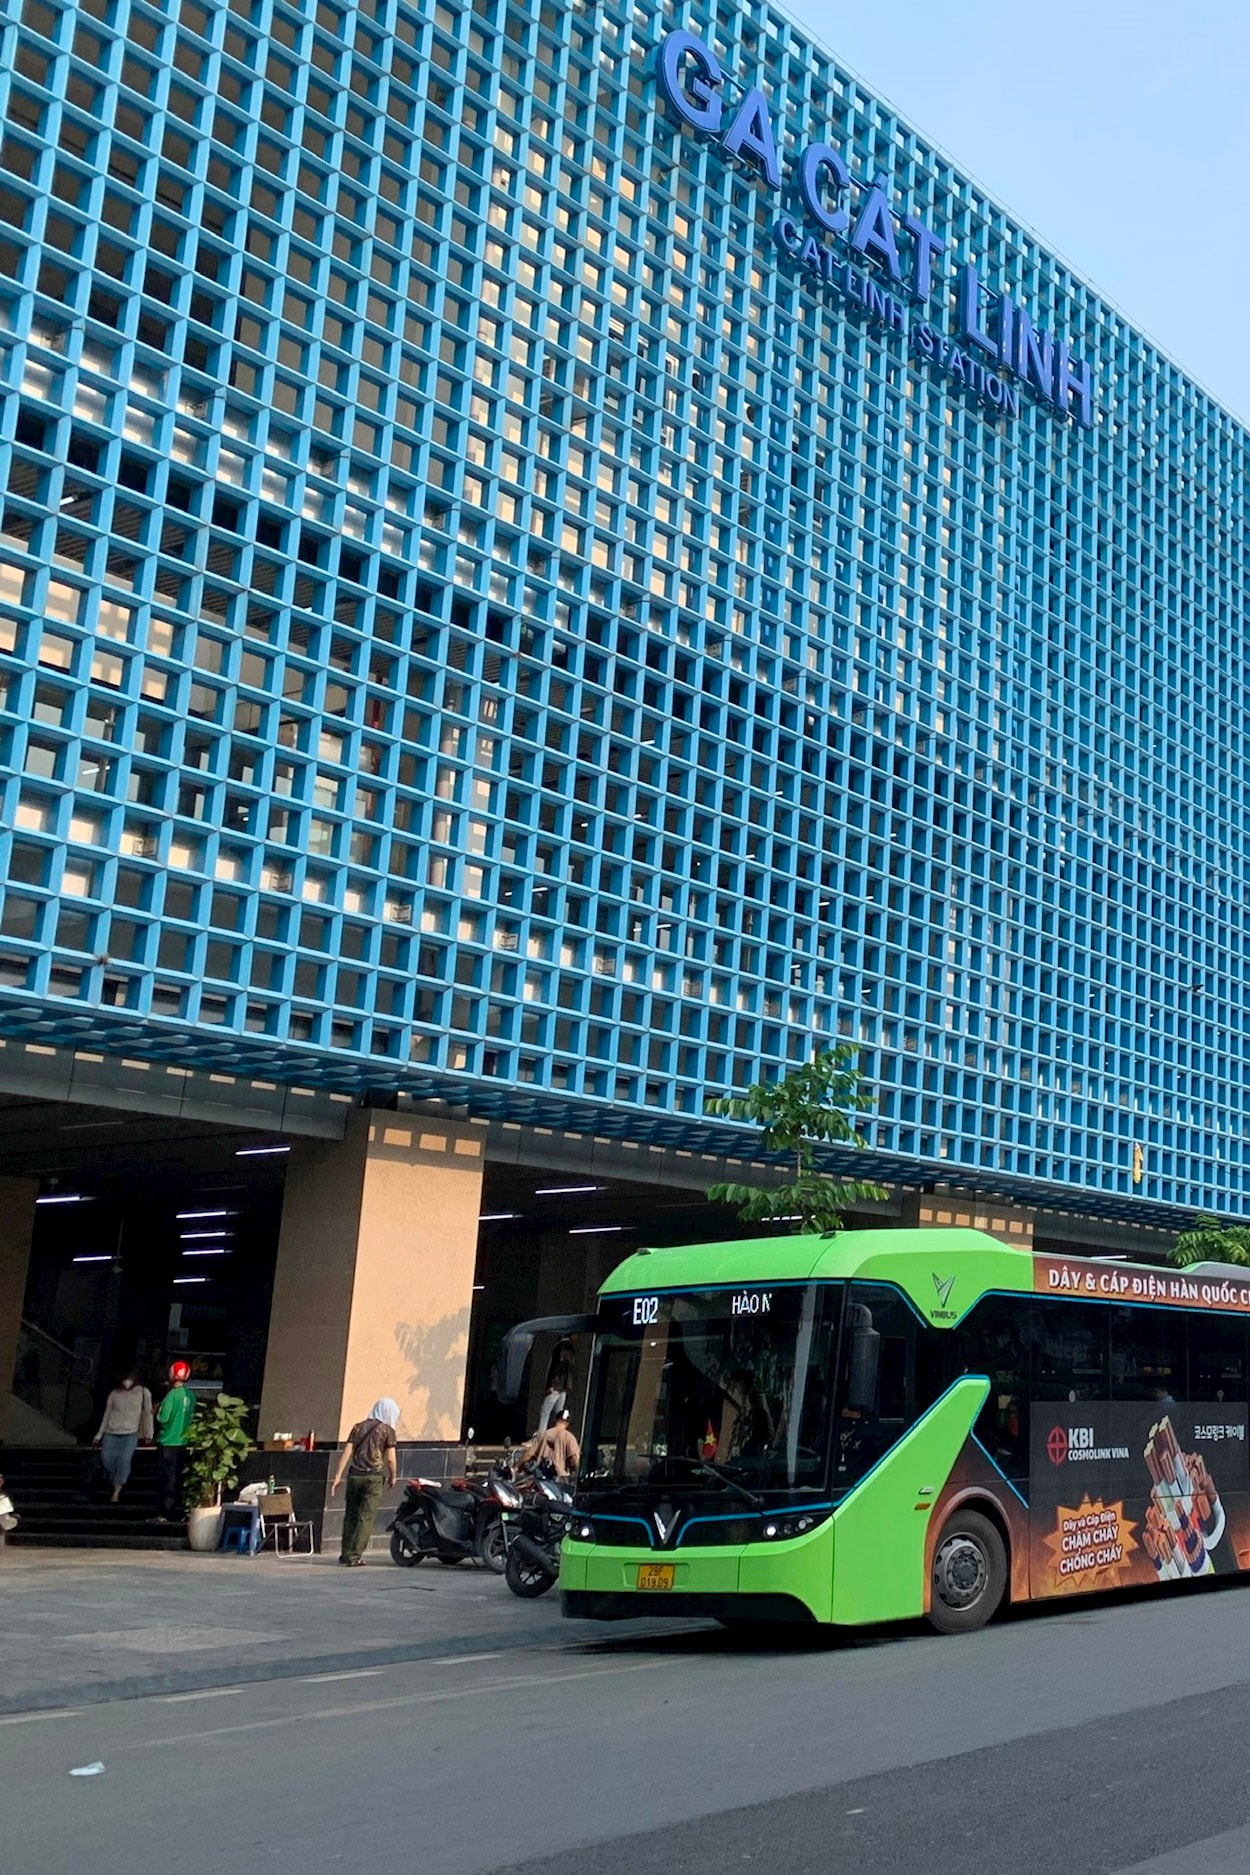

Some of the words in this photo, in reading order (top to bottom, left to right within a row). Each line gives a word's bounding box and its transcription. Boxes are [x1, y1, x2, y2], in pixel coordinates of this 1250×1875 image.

[656, 29, 782, 192] GA
[799, 143, 945, 304] CÁT
[960, 264, 1093, 430] LINH
[773, 216, 840, 280] CAT
[841, 264, 907, 331] LINH
[913, 321, 1019, 418] STATION
[1048, 1265, 1082, 1289] DÂY
[1085, 1272, 1097, 1292] &
[1099, 1270, 1130, 1294] CÁP
[1131, 1274, 1168, 1300] ĐIỆN
[1170, 1278, 1198, 1300] HÀN
[1201, 1281, 1238, 1305] QUỐC
[632, 1296, 660, 1326] E02
[731, 1290, 760, 1315] HÀO
[1068, 1428, 1095, 1449] KBI
[1067, 1448, 1112, 1462] COSMOLINK
[1112, 1447, 1130, 1460] VINA
[1063, 1519, 1077, 1532] Dây
[1093, 1523, 1119, 1544] CHÁY
[1096, 1544, 1123, 1565] CHÁY
